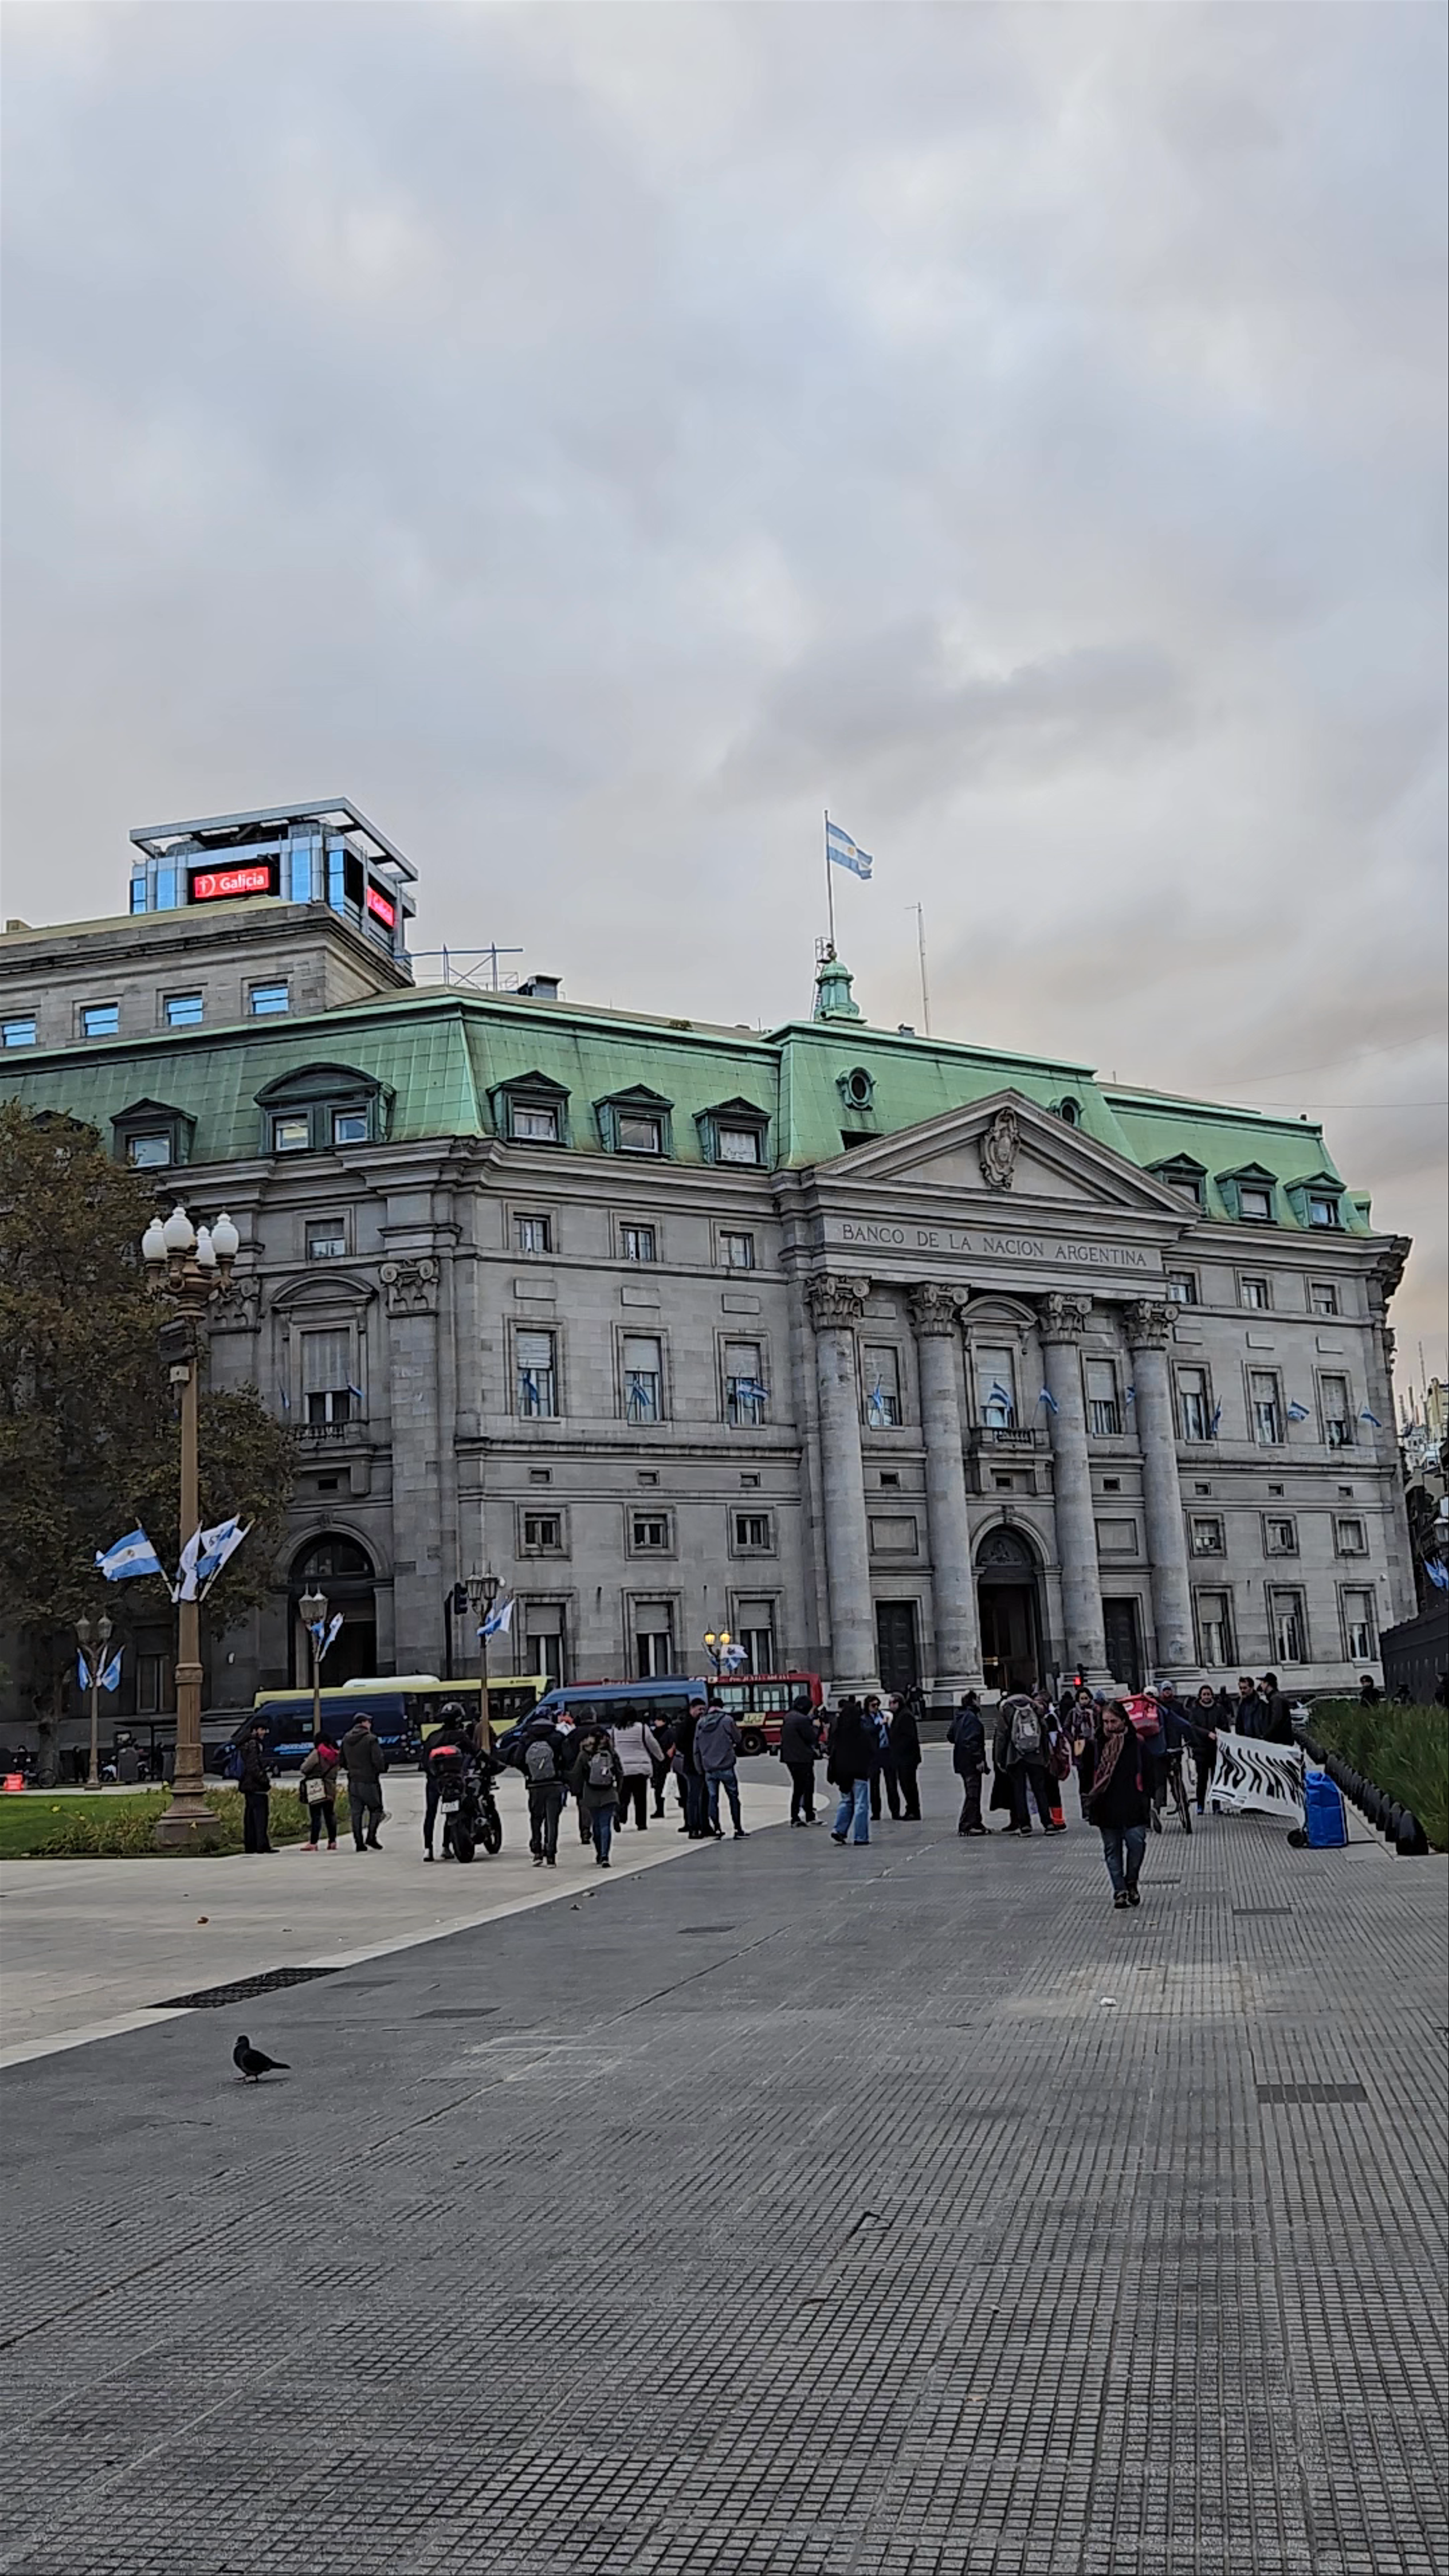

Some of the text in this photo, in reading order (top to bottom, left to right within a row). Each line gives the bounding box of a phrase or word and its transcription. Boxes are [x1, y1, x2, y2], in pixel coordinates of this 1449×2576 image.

[220, 873, 264, 890] Galicia
[843, 1224, 1146, 1267] BANCO DE LA NACION ARGENTINA
